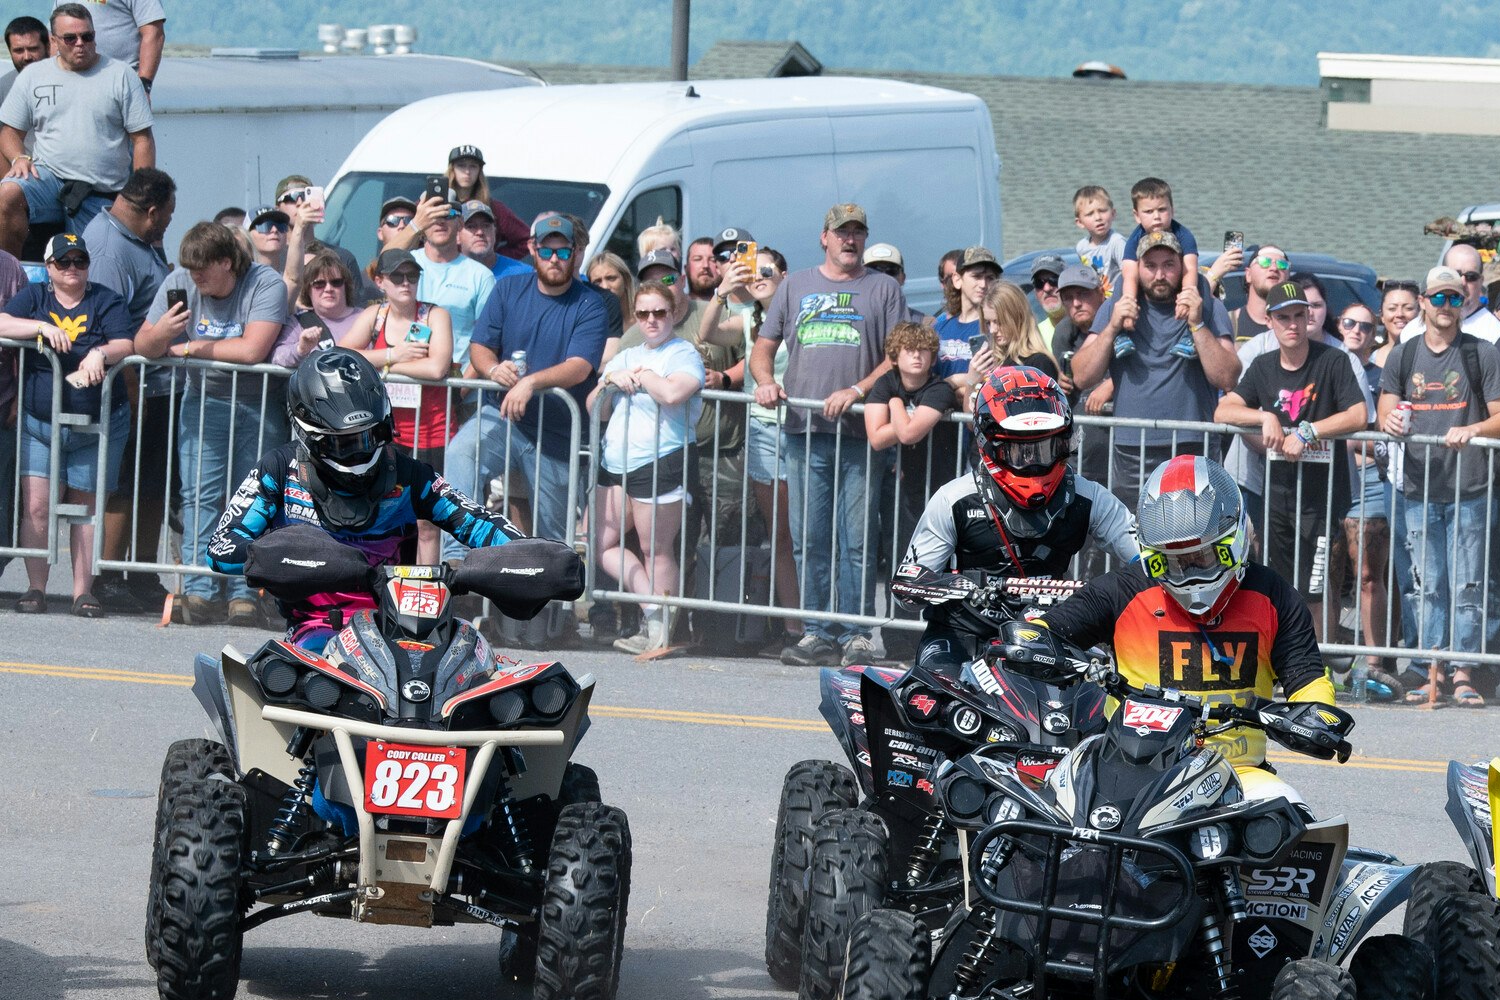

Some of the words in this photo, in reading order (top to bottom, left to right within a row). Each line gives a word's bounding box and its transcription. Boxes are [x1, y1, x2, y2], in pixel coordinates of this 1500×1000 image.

[347, 411, 370, 422] BELL
[1006, 577, 1085, 588] RENTHAL
[1006, 586, 1076, 596] RENTHA
[400, 596, 440, 615] 823
[1033, 654, 1056, 665] CYCRA
[1171, 641, 1247, 682] FLY
[1125, 706, 1178, 729] 204
[1289, 725, 1314, 738] CYCRA
[888, 738, 939, 758] can-am
[386, 750, 411, 760] CODY
[411, 752, 446, 763] COLLIER
[371, 760, 459, 811] 823
[1101, 816, 1119, 824] BRP
[1289, 891, 1310, 899] RACING
[1333, 912, 1359, 949] RIVAL
